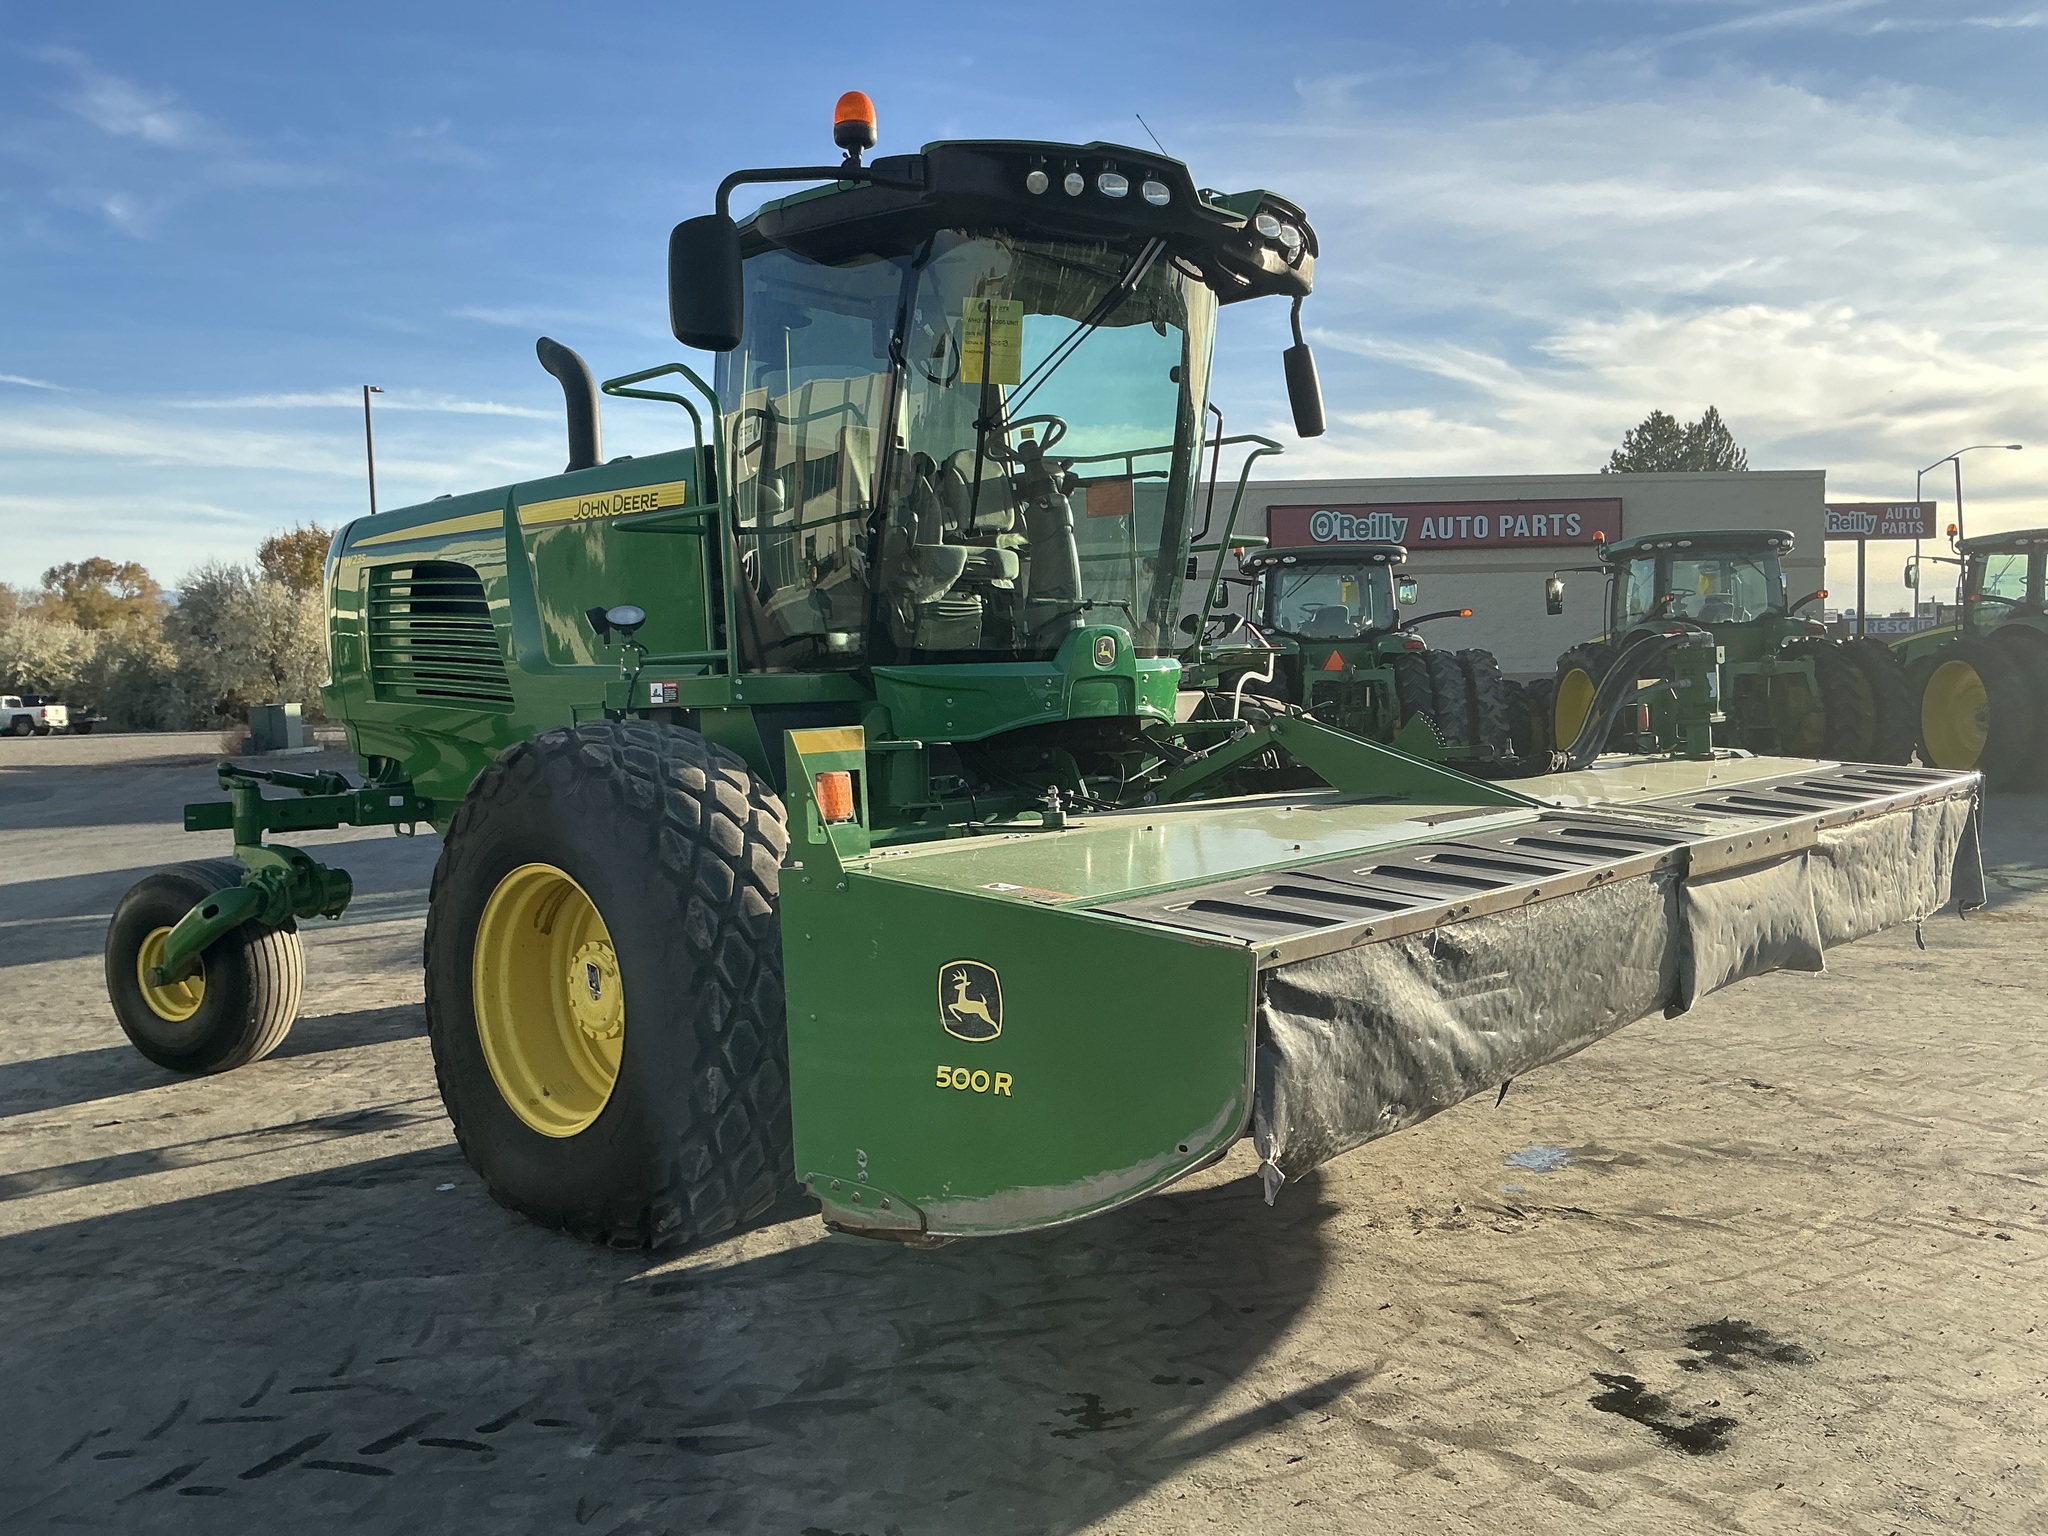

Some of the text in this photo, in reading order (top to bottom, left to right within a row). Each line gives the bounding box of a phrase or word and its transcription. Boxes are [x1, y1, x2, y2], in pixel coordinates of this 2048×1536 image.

[573, 493, 659, 518] JOHN DEERE
[1885, 507, 1921, 520] AUTO
[1309, 510, 1582, 544] O'Reilly AUTO PARTS
[1824, 508, 1878, 535] 'Reilly
[1881, 521, 1925, 535] PARTS
